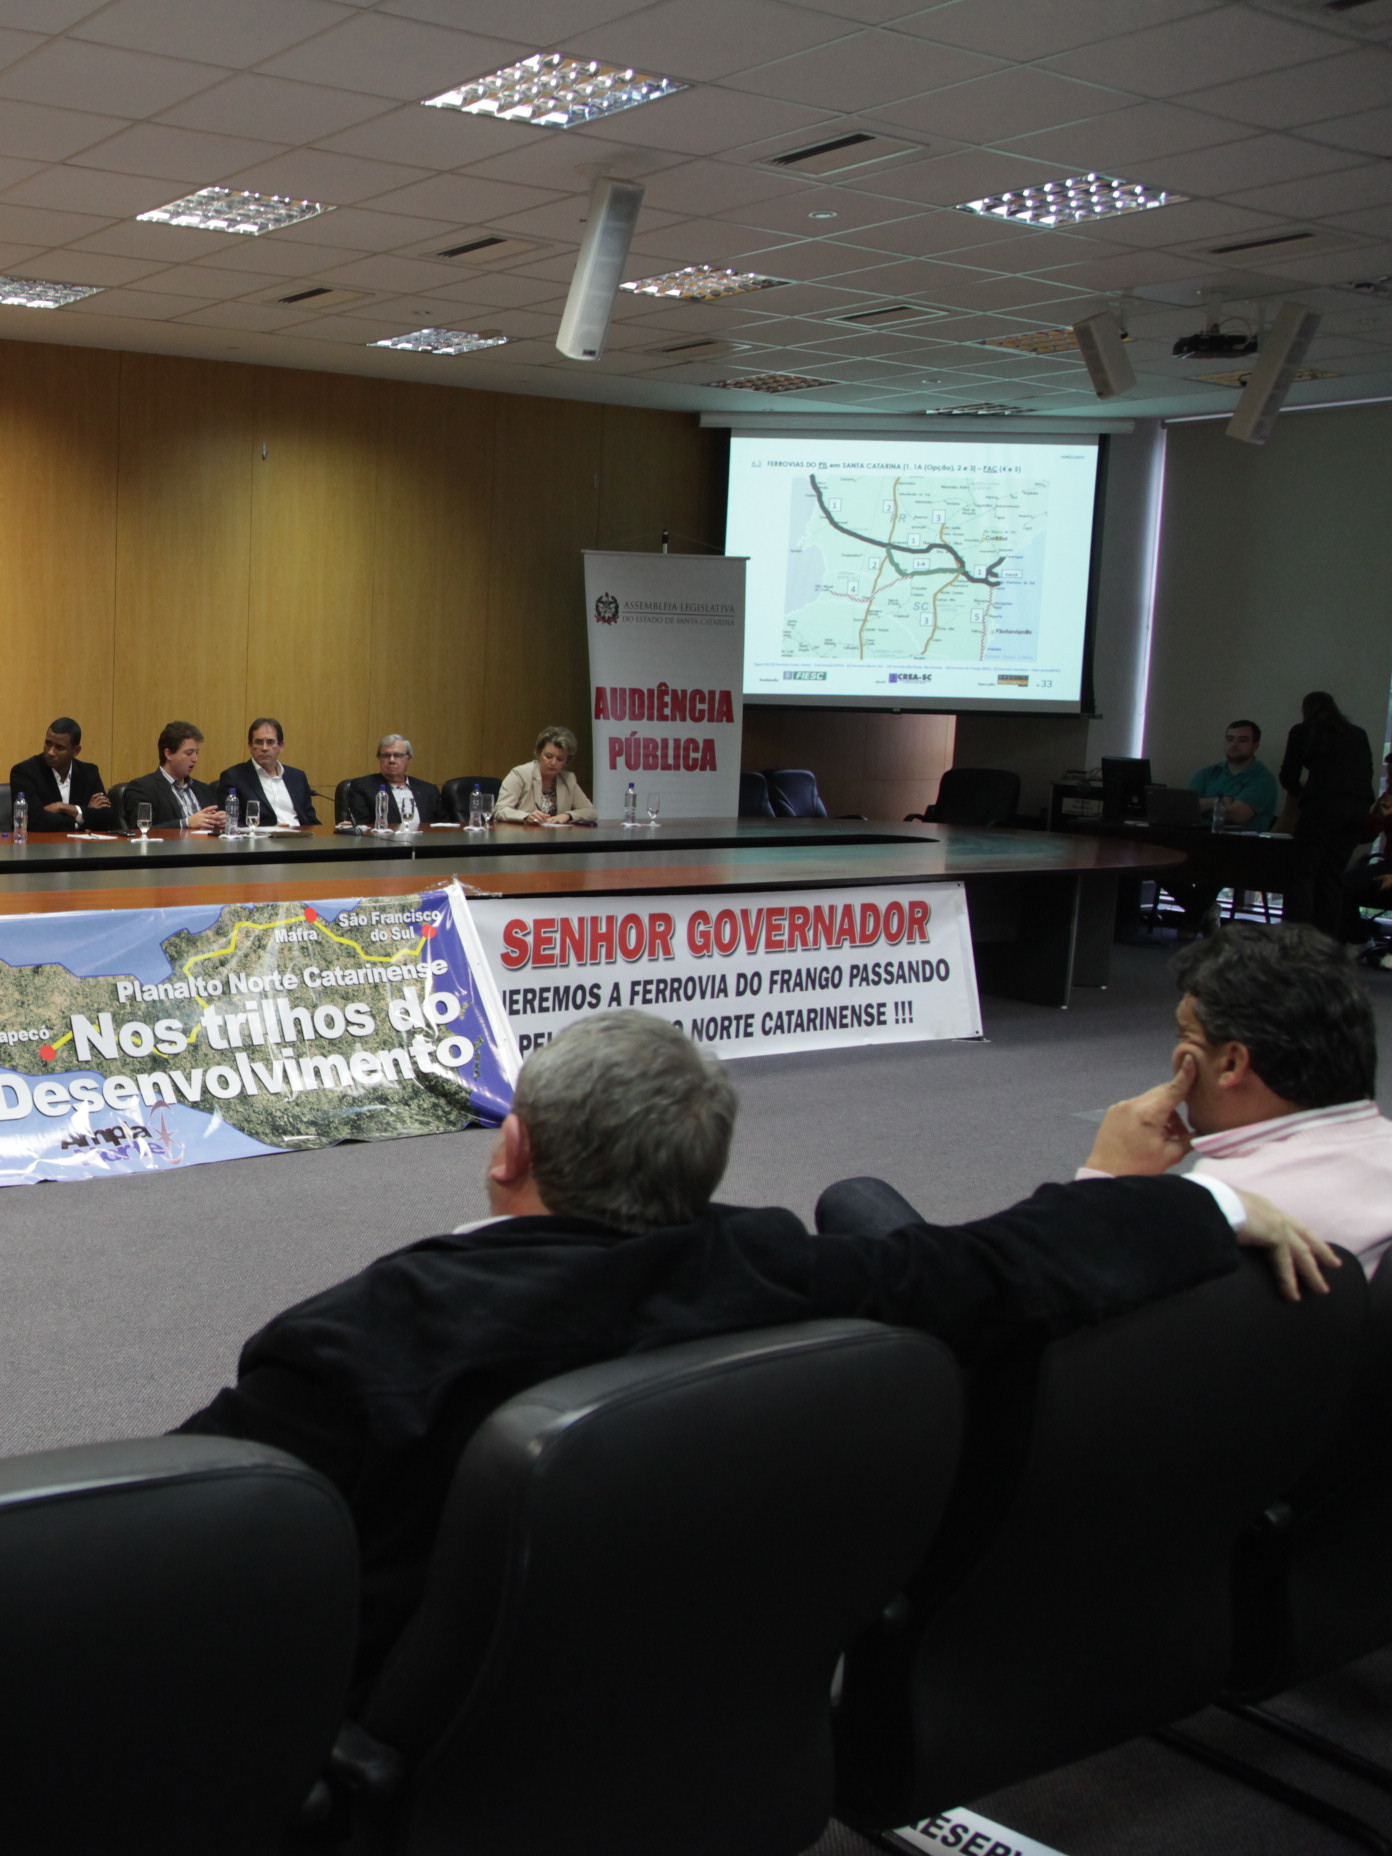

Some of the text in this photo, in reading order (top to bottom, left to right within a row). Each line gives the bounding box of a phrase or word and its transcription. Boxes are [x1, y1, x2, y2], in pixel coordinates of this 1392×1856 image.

[766, 460, 804, 468] FERROVIAS
[983, 466, 998, 474] PAC
[680, 602, 735, 614] LEGISLATIVA
[912, 601, 929, 611] SC
[622, 615, 735, 626] DO ESTADO DE SANTA CATARINA
[795, 671, 825, 680] FIESC
[897, 673, 933, 682] CREA-SC
[1041, 679, 1054, 689] 33
[594, 681, 735, 724] AUDIÊNCIA
[608, 730, 718, 772] PÚBLICA
[338, 909, 441, 928] São Francisco
[274, 928, 318, 944] Mafra
[370, 926, 415, 943] do Sul
[499, 900, 931, 970] SENHOR GOVERNADOR
[116, 958, 449, 1004] Planalto Norte Catarinense
[502, 957, 951, 1016] EREMOS A FERROVIA DO FRANGO PASSANDO
[69, 985, 462, 1063] Nos trilhos do
[691, 1012, 756, 1043] NORTE
[761, 1001, 888, 1037] CATARINENSE
[893, 1000, 915, 1026] !!!
[73, 1140, 166, 1166] orte
[908, 1813, 1024, 1856] ESER
